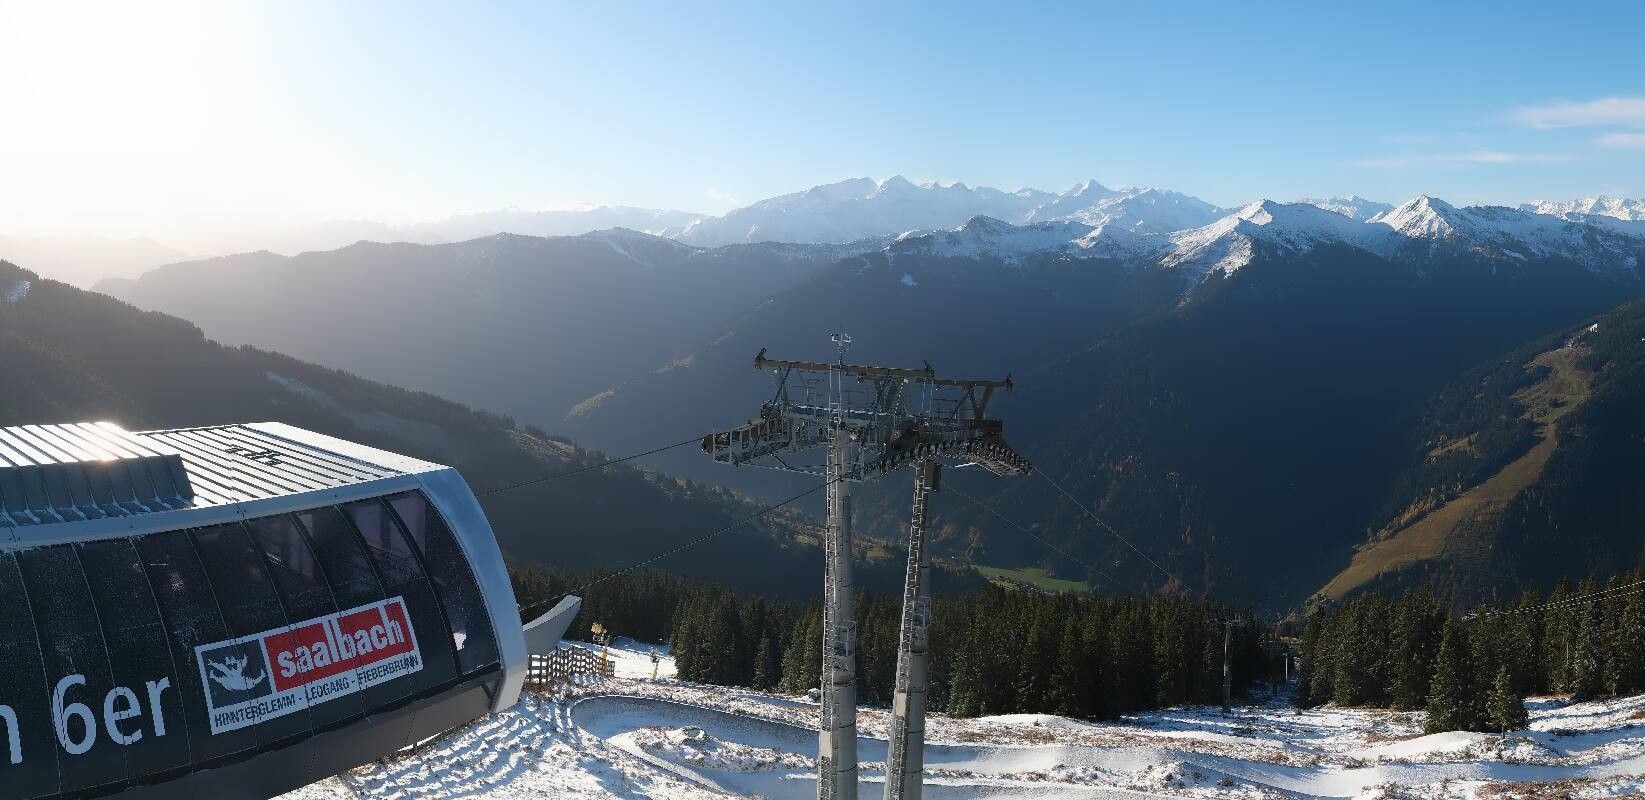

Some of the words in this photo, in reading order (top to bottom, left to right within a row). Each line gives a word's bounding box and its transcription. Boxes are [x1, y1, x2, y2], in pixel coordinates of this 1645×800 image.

[277, 606, 406, 678] saalbach
[52, 674, 171, 755] 6er
[304, 676, 350, 702] LEOGANG
